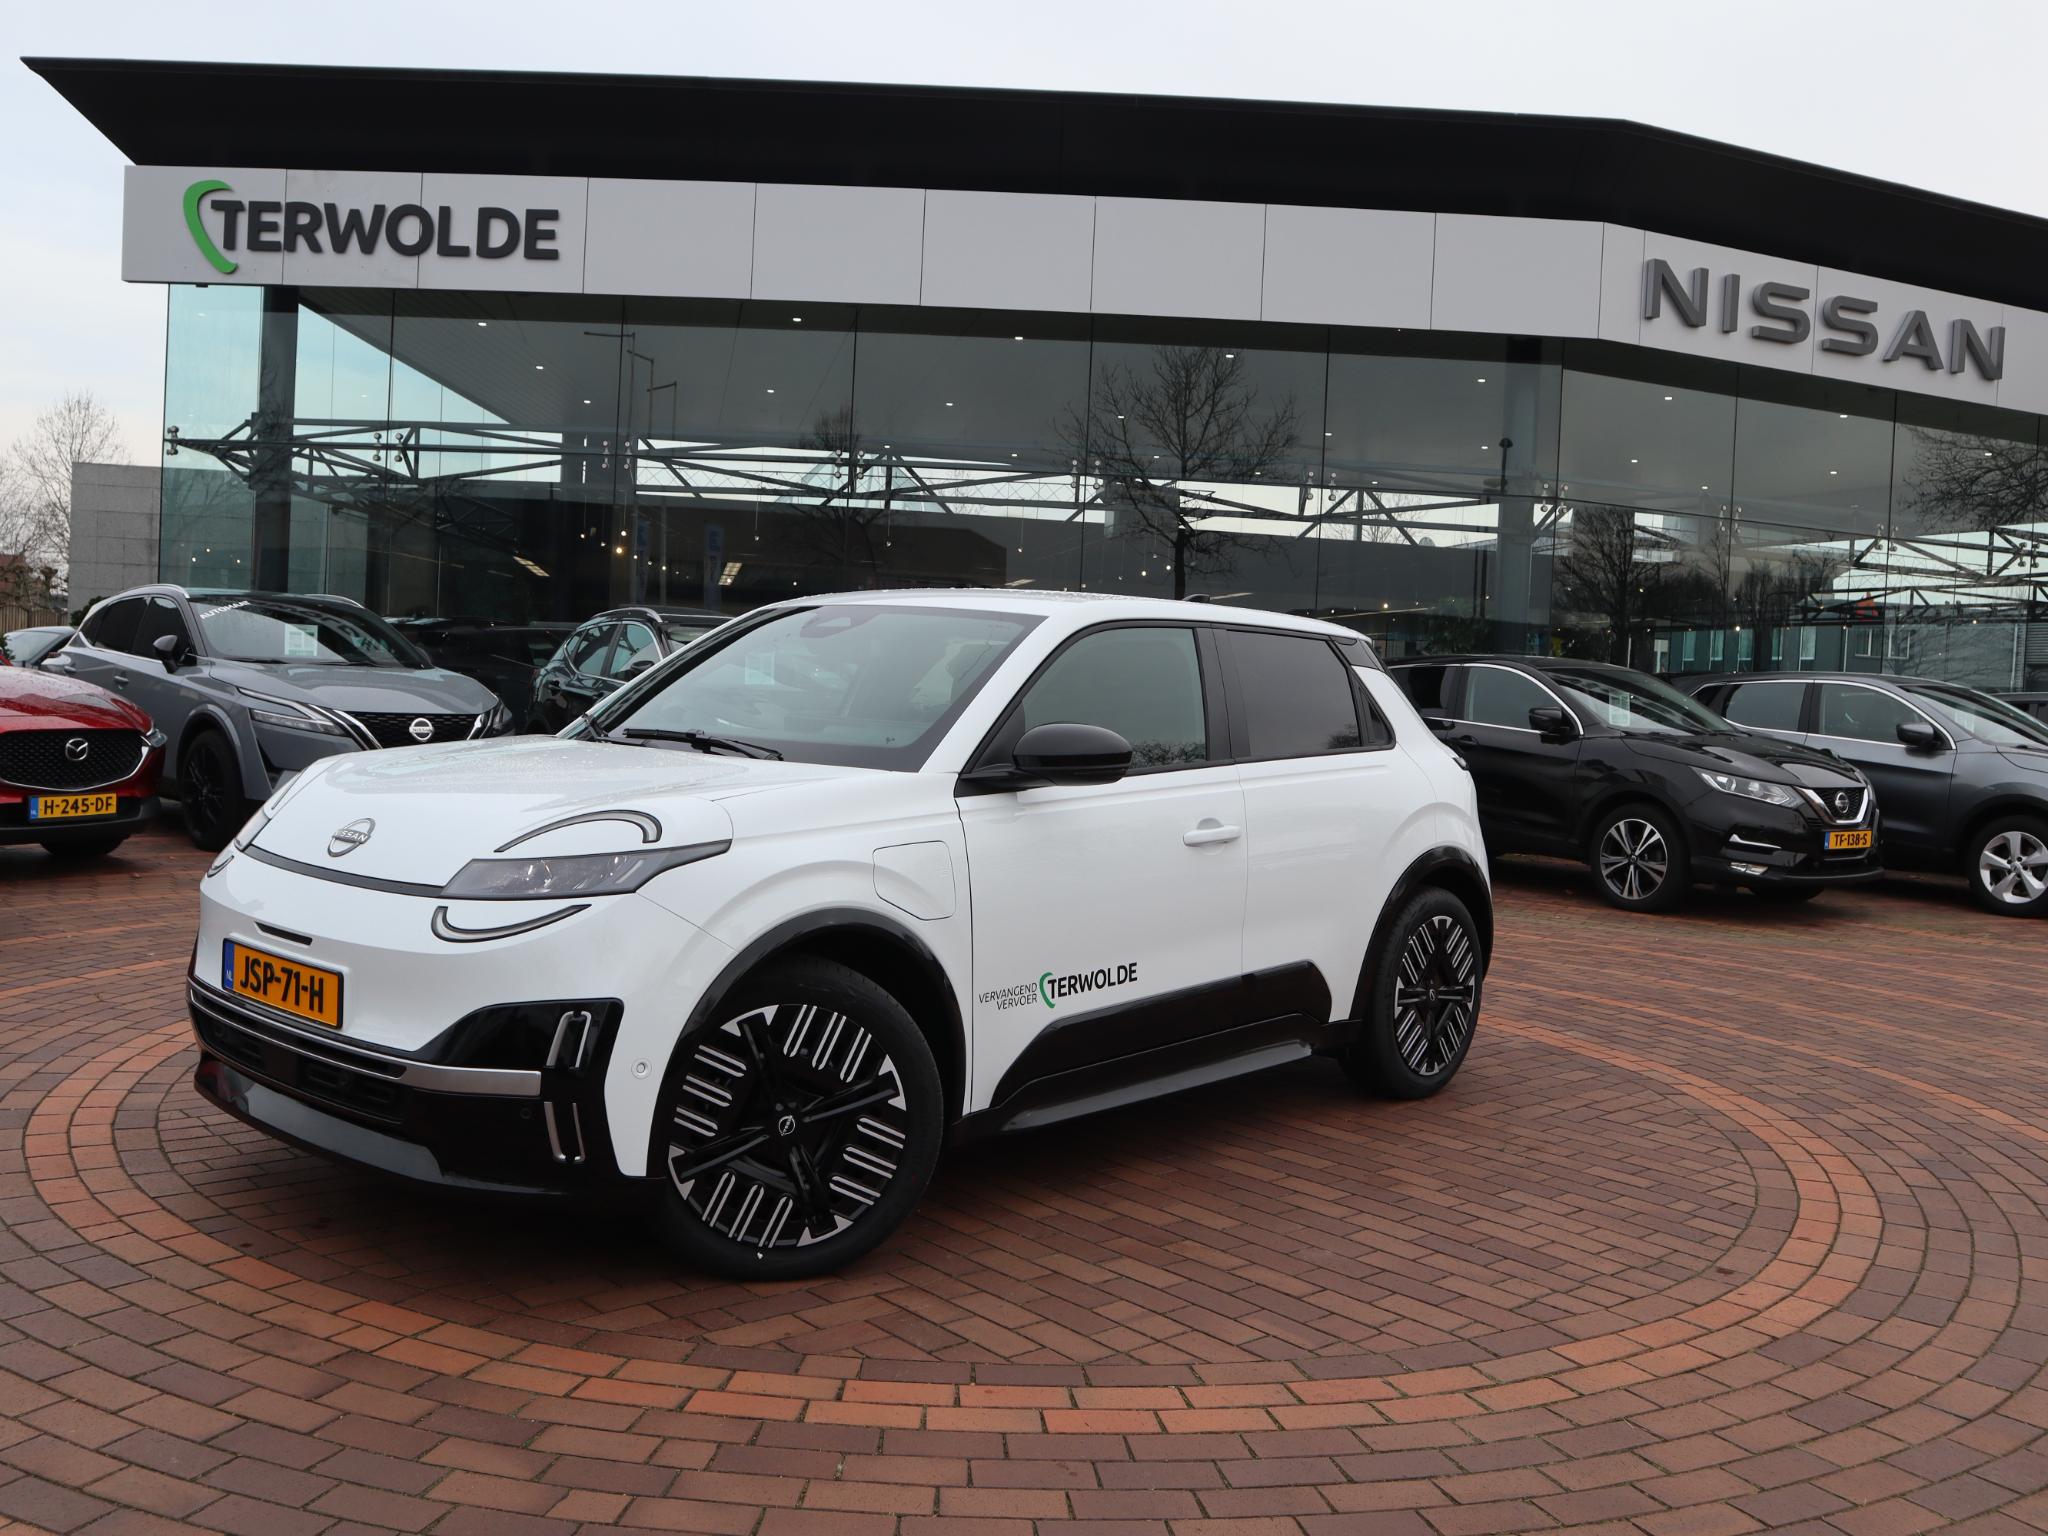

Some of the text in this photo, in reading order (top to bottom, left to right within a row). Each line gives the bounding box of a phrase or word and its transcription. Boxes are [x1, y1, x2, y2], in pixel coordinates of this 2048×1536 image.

[210, 199, 560, 261] TERWOLDE
[1644, 258, 2006, 381] NISSAN
[44, 796, 113, 815] H-245-DF
[335, 829, 369, 842] SSAN
[1834, 833, 1868, 847] TF-138-S
[239, 955, 324, 1014] JSP-71-H
[1047, 961, 1138, 1000] TERWOLDE
[978, 982, 1038, 1004] VERVANGEND
[996, 993, 1038, 1011] VERVOER
